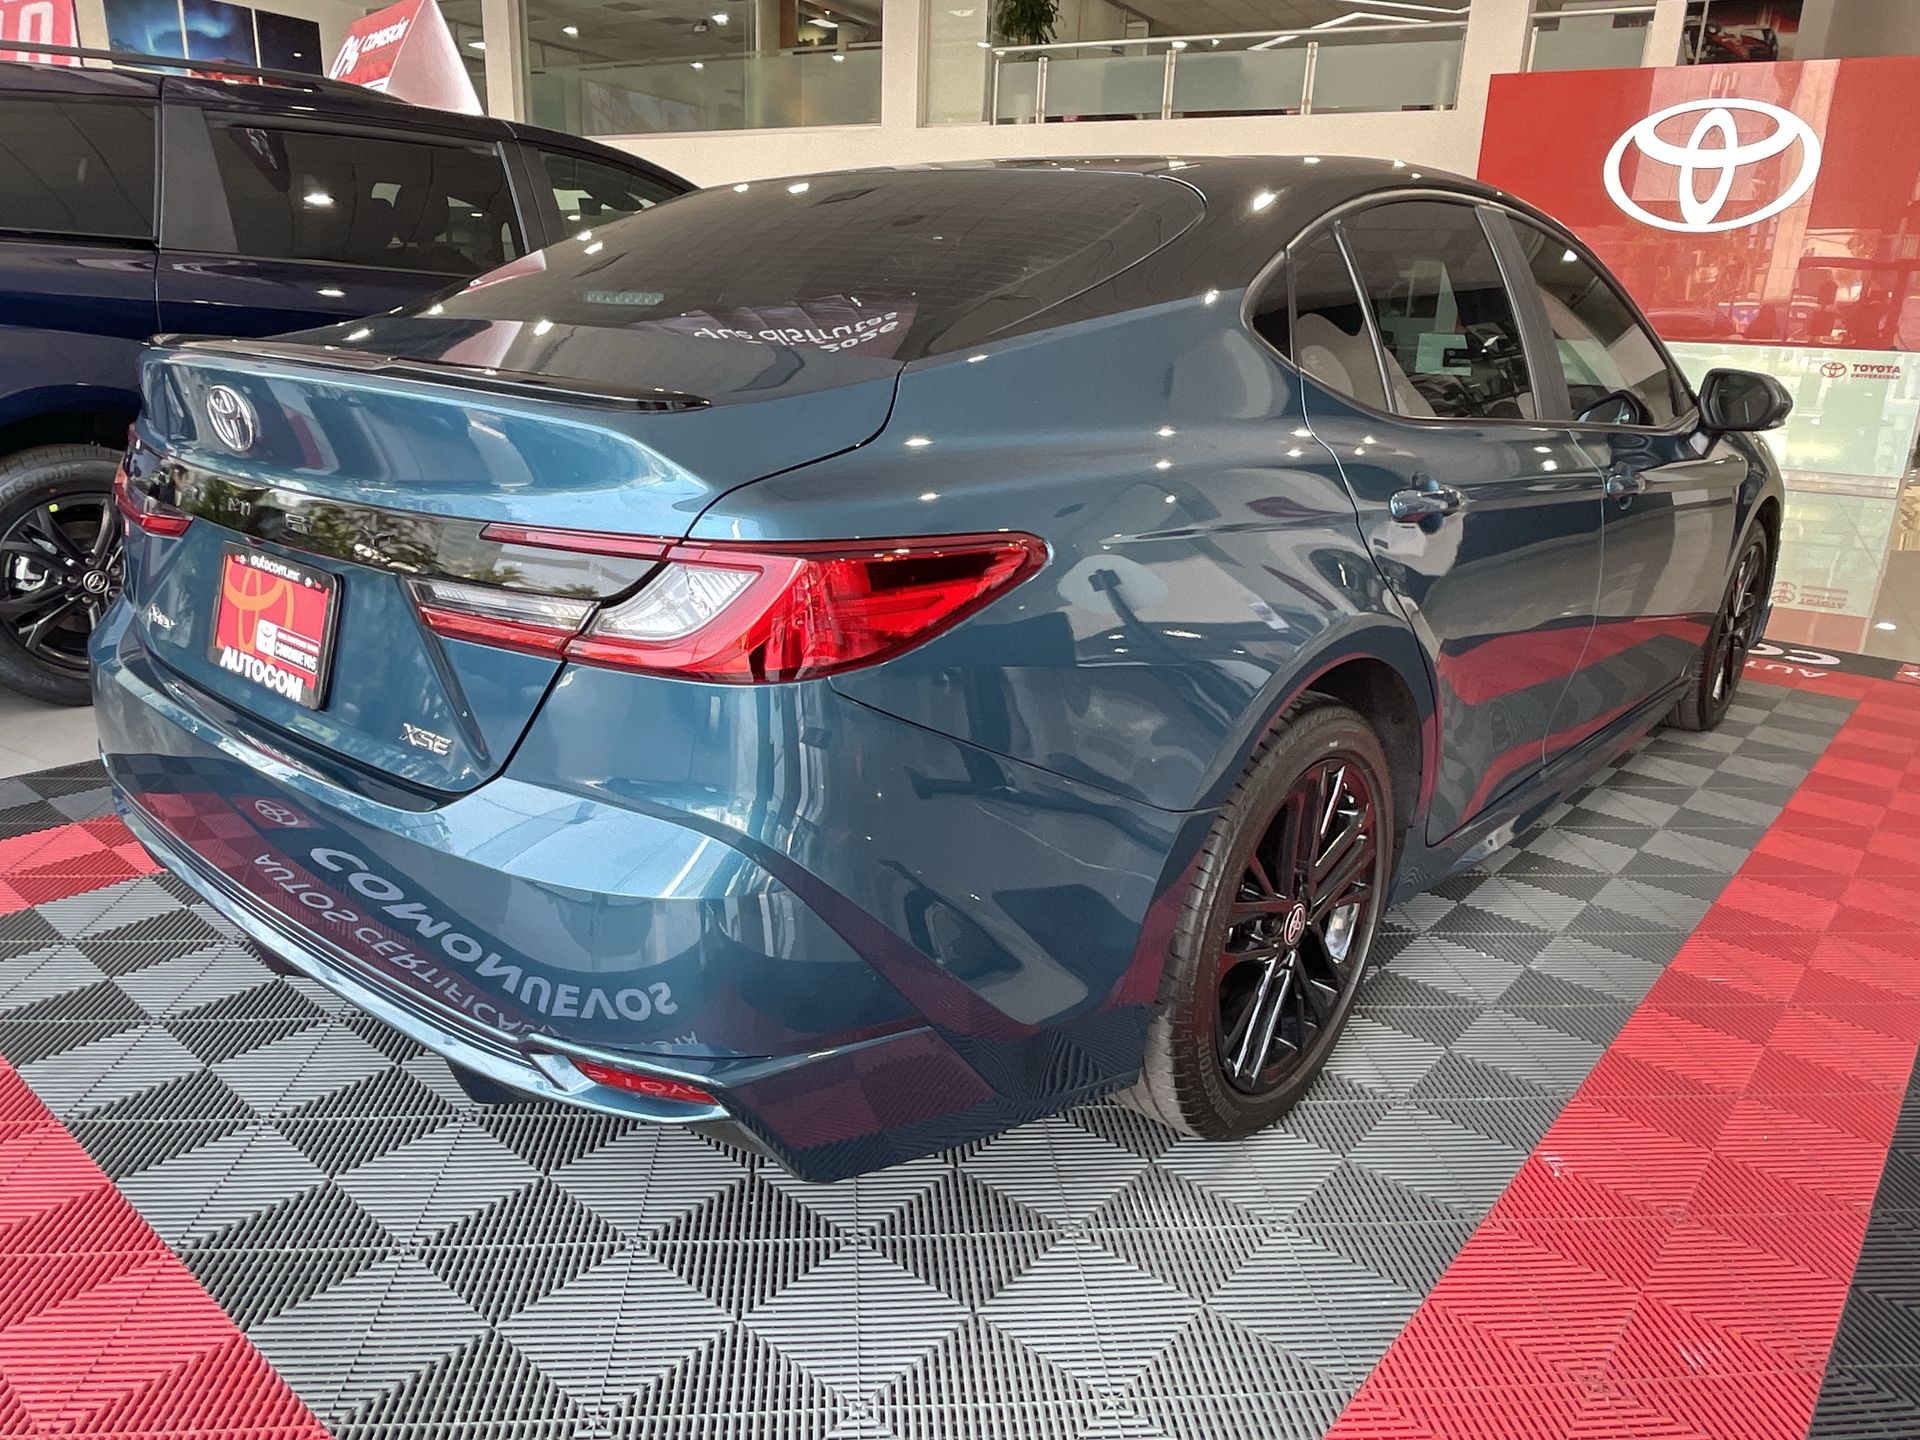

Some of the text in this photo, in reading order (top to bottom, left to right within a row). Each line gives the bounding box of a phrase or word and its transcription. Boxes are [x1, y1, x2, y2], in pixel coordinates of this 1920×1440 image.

[1852, 363, 1901, 374] TOYOTA
[219, 645, 304, 702] AUTOCOM
[399, 722, 453, 756] XSE
